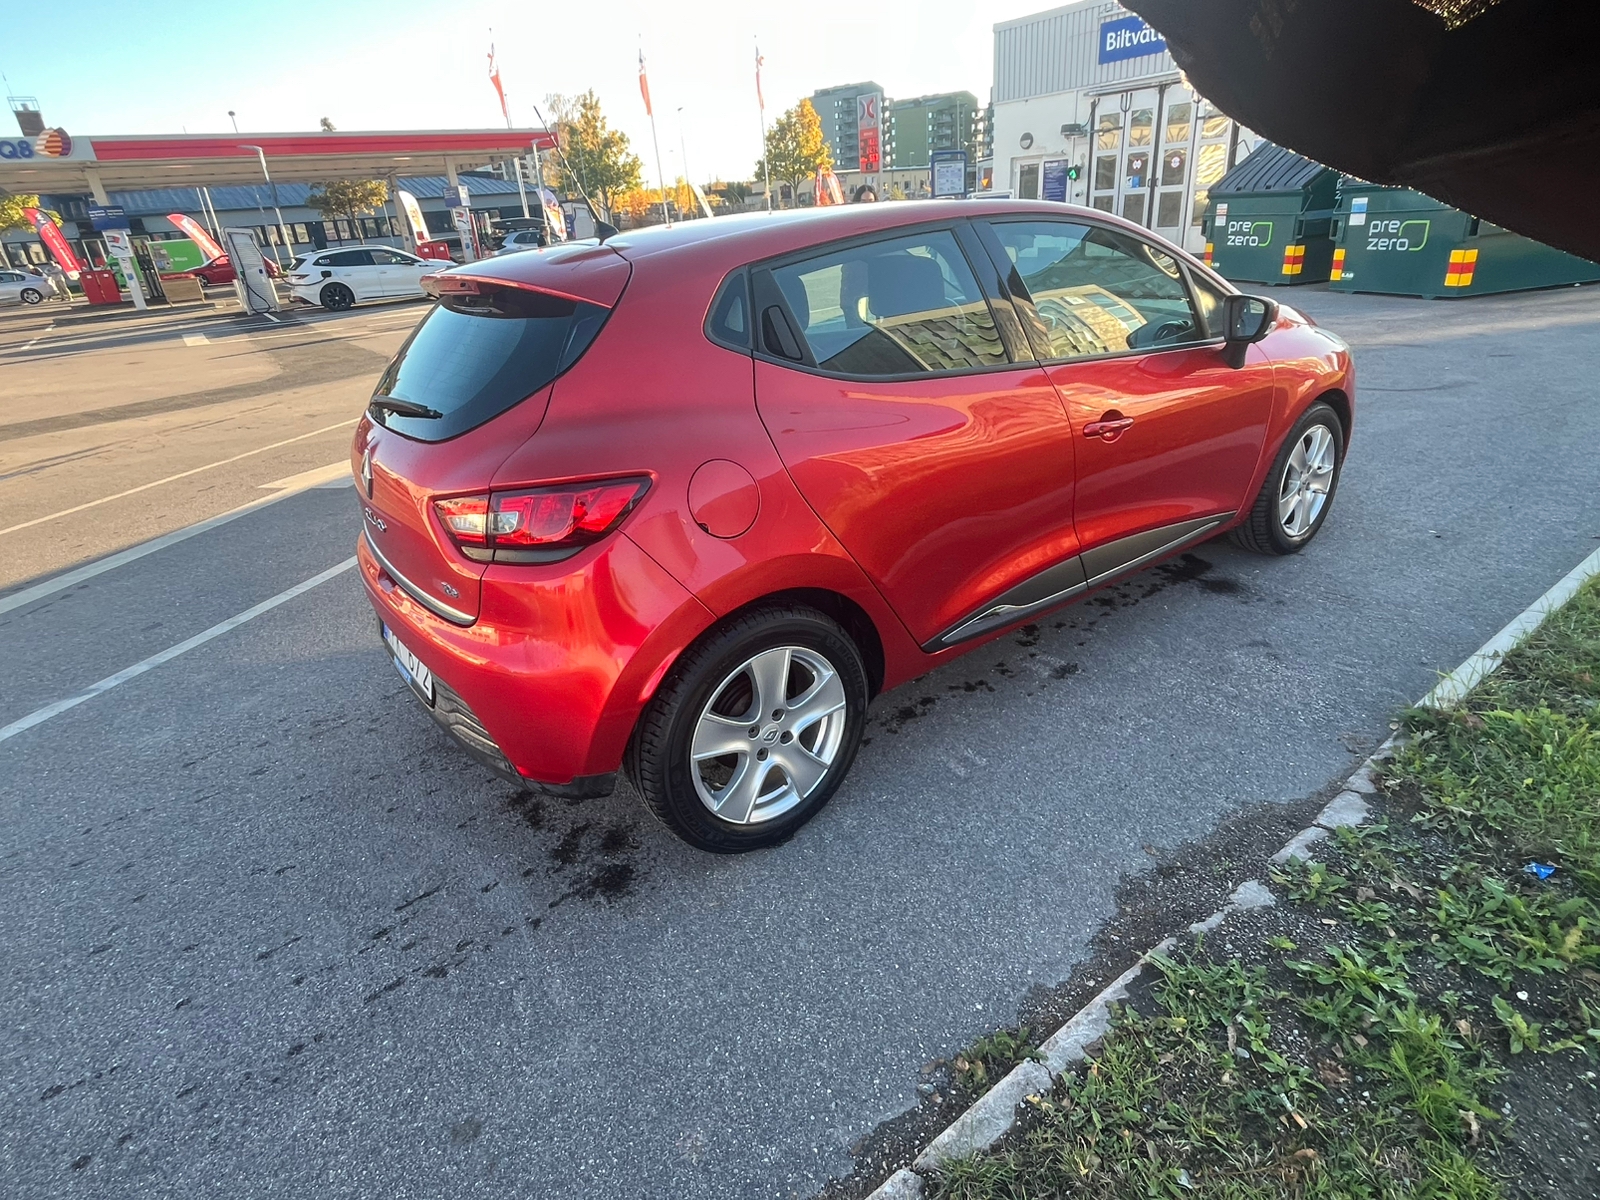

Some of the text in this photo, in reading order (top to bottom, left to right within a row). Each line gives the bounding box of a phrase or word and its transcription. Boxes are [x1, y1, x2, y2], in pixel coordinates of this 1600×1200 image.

[0, 140, 34, 159] Q8
[1228, 221, 1252, 234] pre
[1369, 220, 1401, 236] pre
[1227, 235, 1259, 247] zero
[1366, 238, 1409, 251] zero
